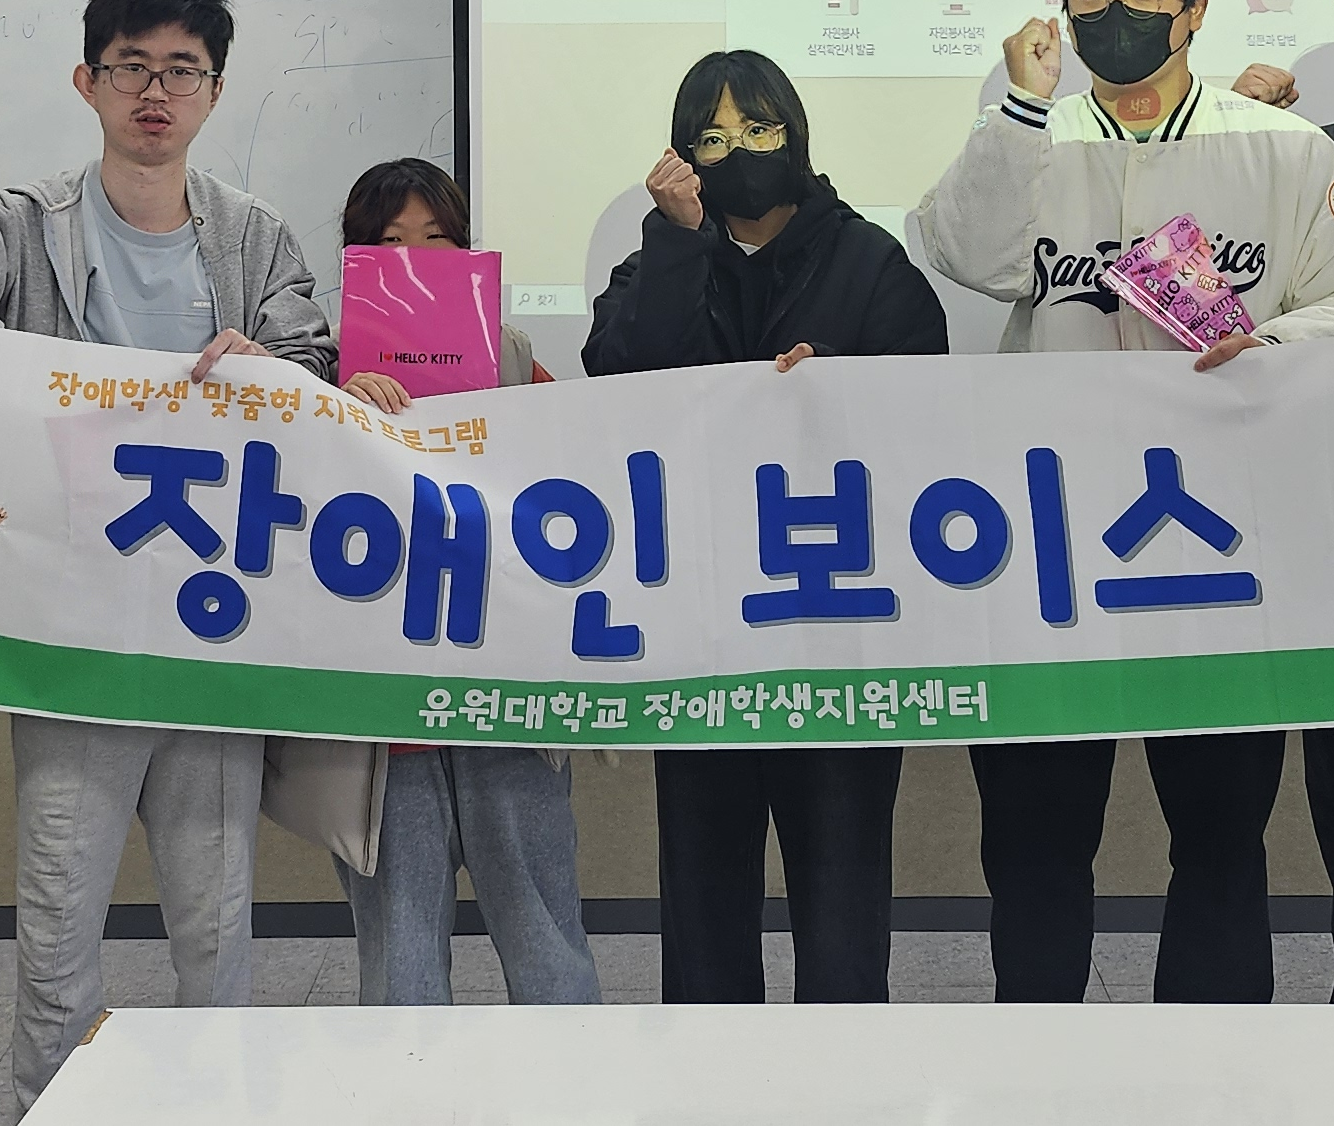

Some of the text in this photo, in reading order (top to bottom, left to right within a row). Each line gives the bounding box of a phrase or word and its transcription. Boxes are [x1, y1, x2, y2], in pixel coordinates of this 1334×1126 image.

[822, 27, 861, 40] 자원봉사
[1132, 238, 1158, 262] KITTY
[1177, 237, 1212, 281] KITTY
[1032, 236, 1096, 309] San
[537, 294, 557, 306] 찾기
[1209, 291, 1236, 315] KITTY
[394, 352, 428, 364] HELLO
[430, 353, 463, 365] KITTY
[47, 370, 488, 456] 장애학생 맞춤형 지원 프로그램
[104, 440, 1263, 662] 장애인 보이스
[417, 678, 990, 733] 유원대학교 장애학생지원센터
